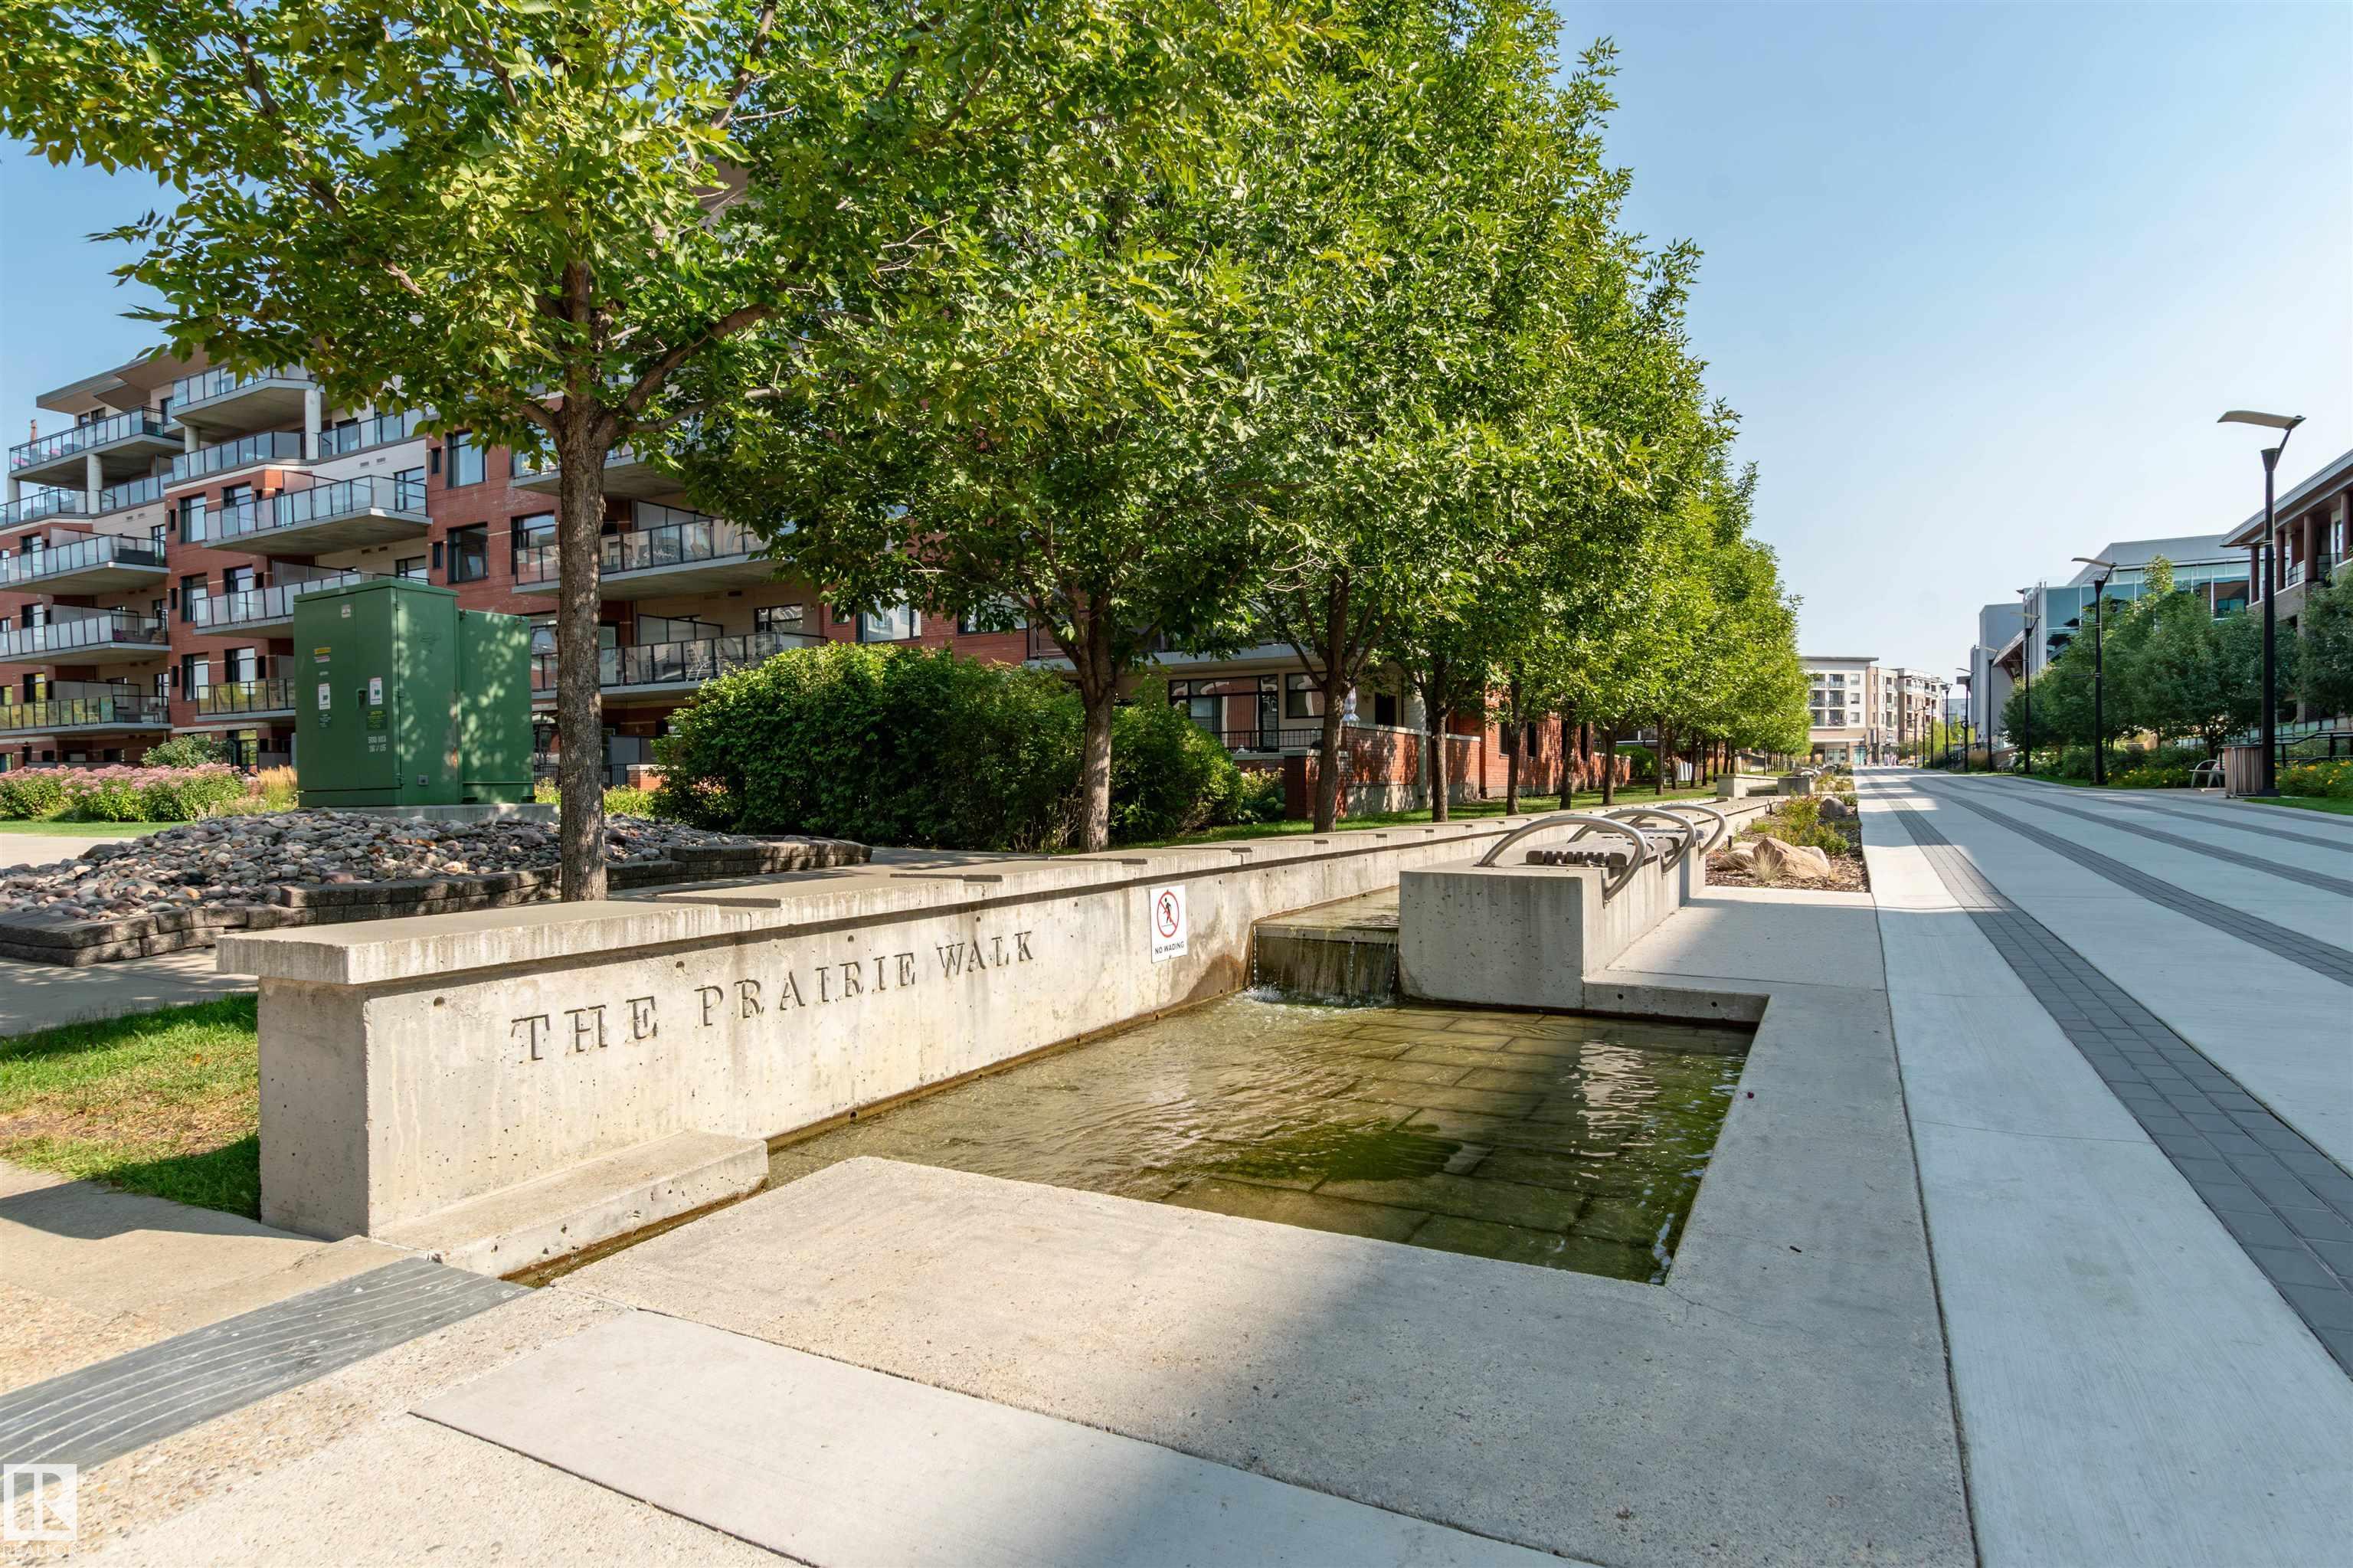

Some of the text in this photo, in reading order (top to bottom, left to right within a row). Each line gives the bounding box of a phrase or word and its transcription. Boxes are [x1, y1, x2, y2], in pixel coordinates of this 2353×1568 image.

[1154, 941, 1184, 954] NO WADING
[511, 930, 1034, 1063] THE PRAIRIE WALK
